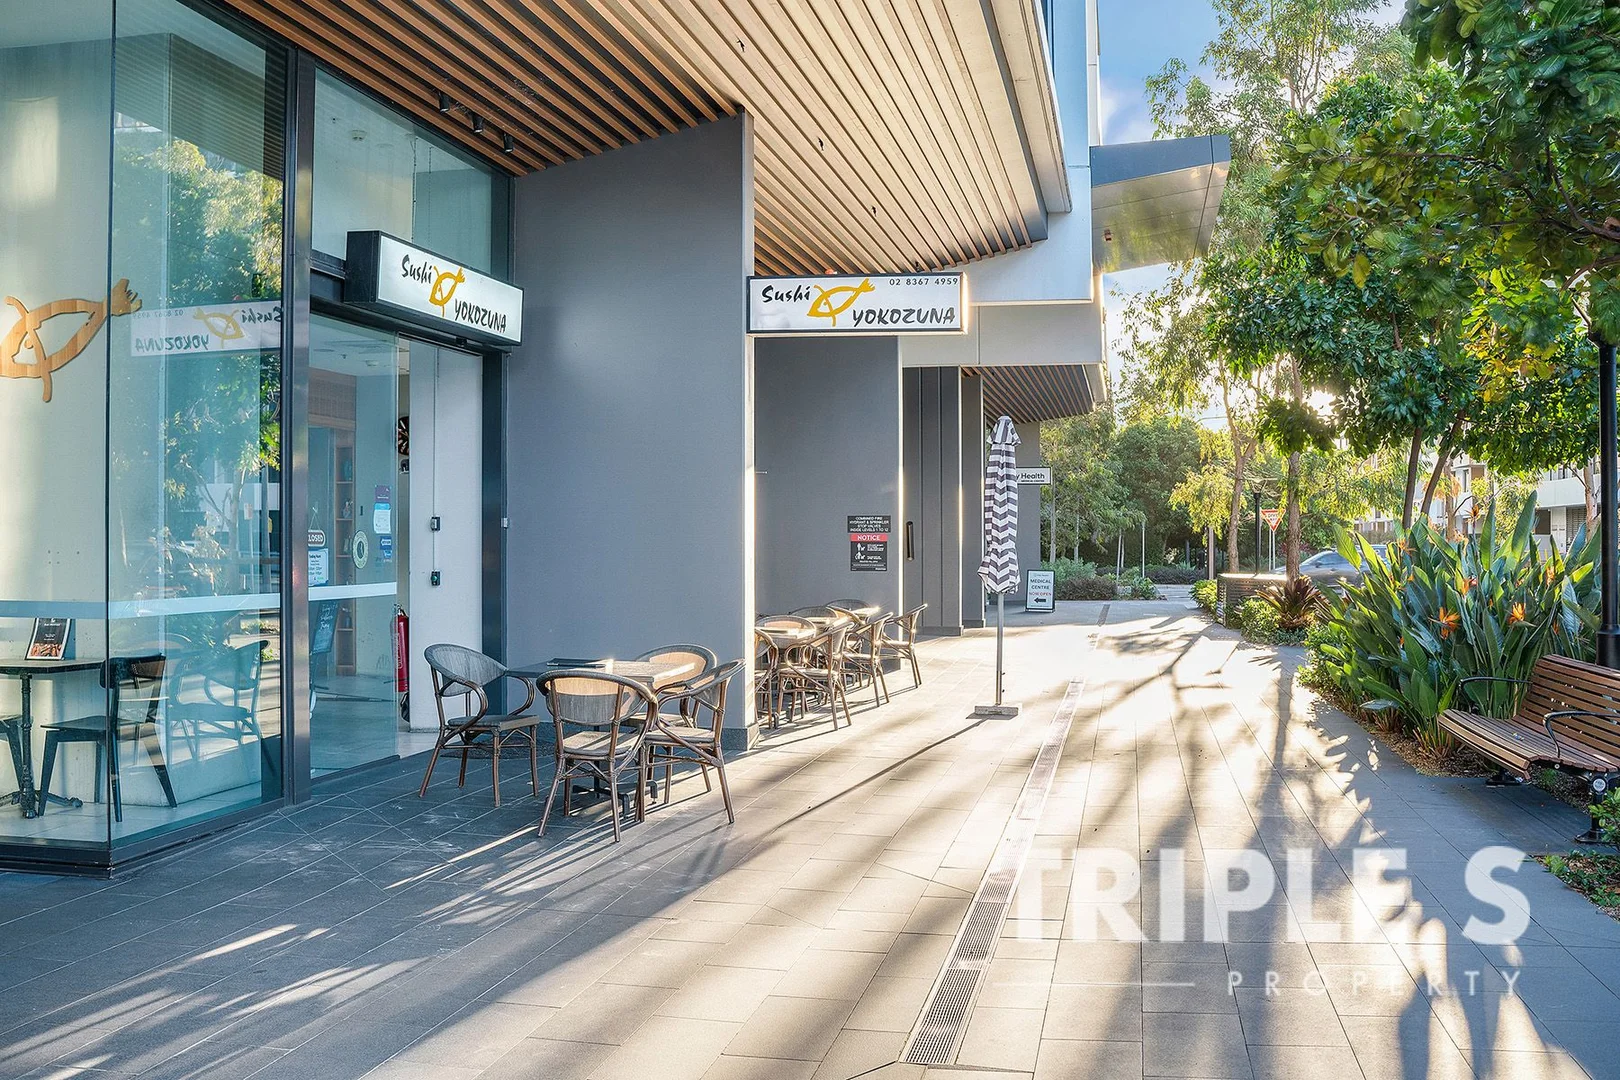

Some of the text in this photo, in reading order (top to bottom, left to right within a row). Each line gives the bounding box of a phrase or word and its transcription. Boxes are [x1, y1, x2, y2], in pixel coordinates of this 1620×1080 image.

[402, 254, 433, 284] Sushi
[889, 277, 958, 286] 02 8367 4959
[761, 284, 811, 303] Sushi
[455, 298, 507, 333] YOKOZUNA
[852, 307, 956, 327] YOKOZUNA
[307, 534, 324, 542] LOSED
